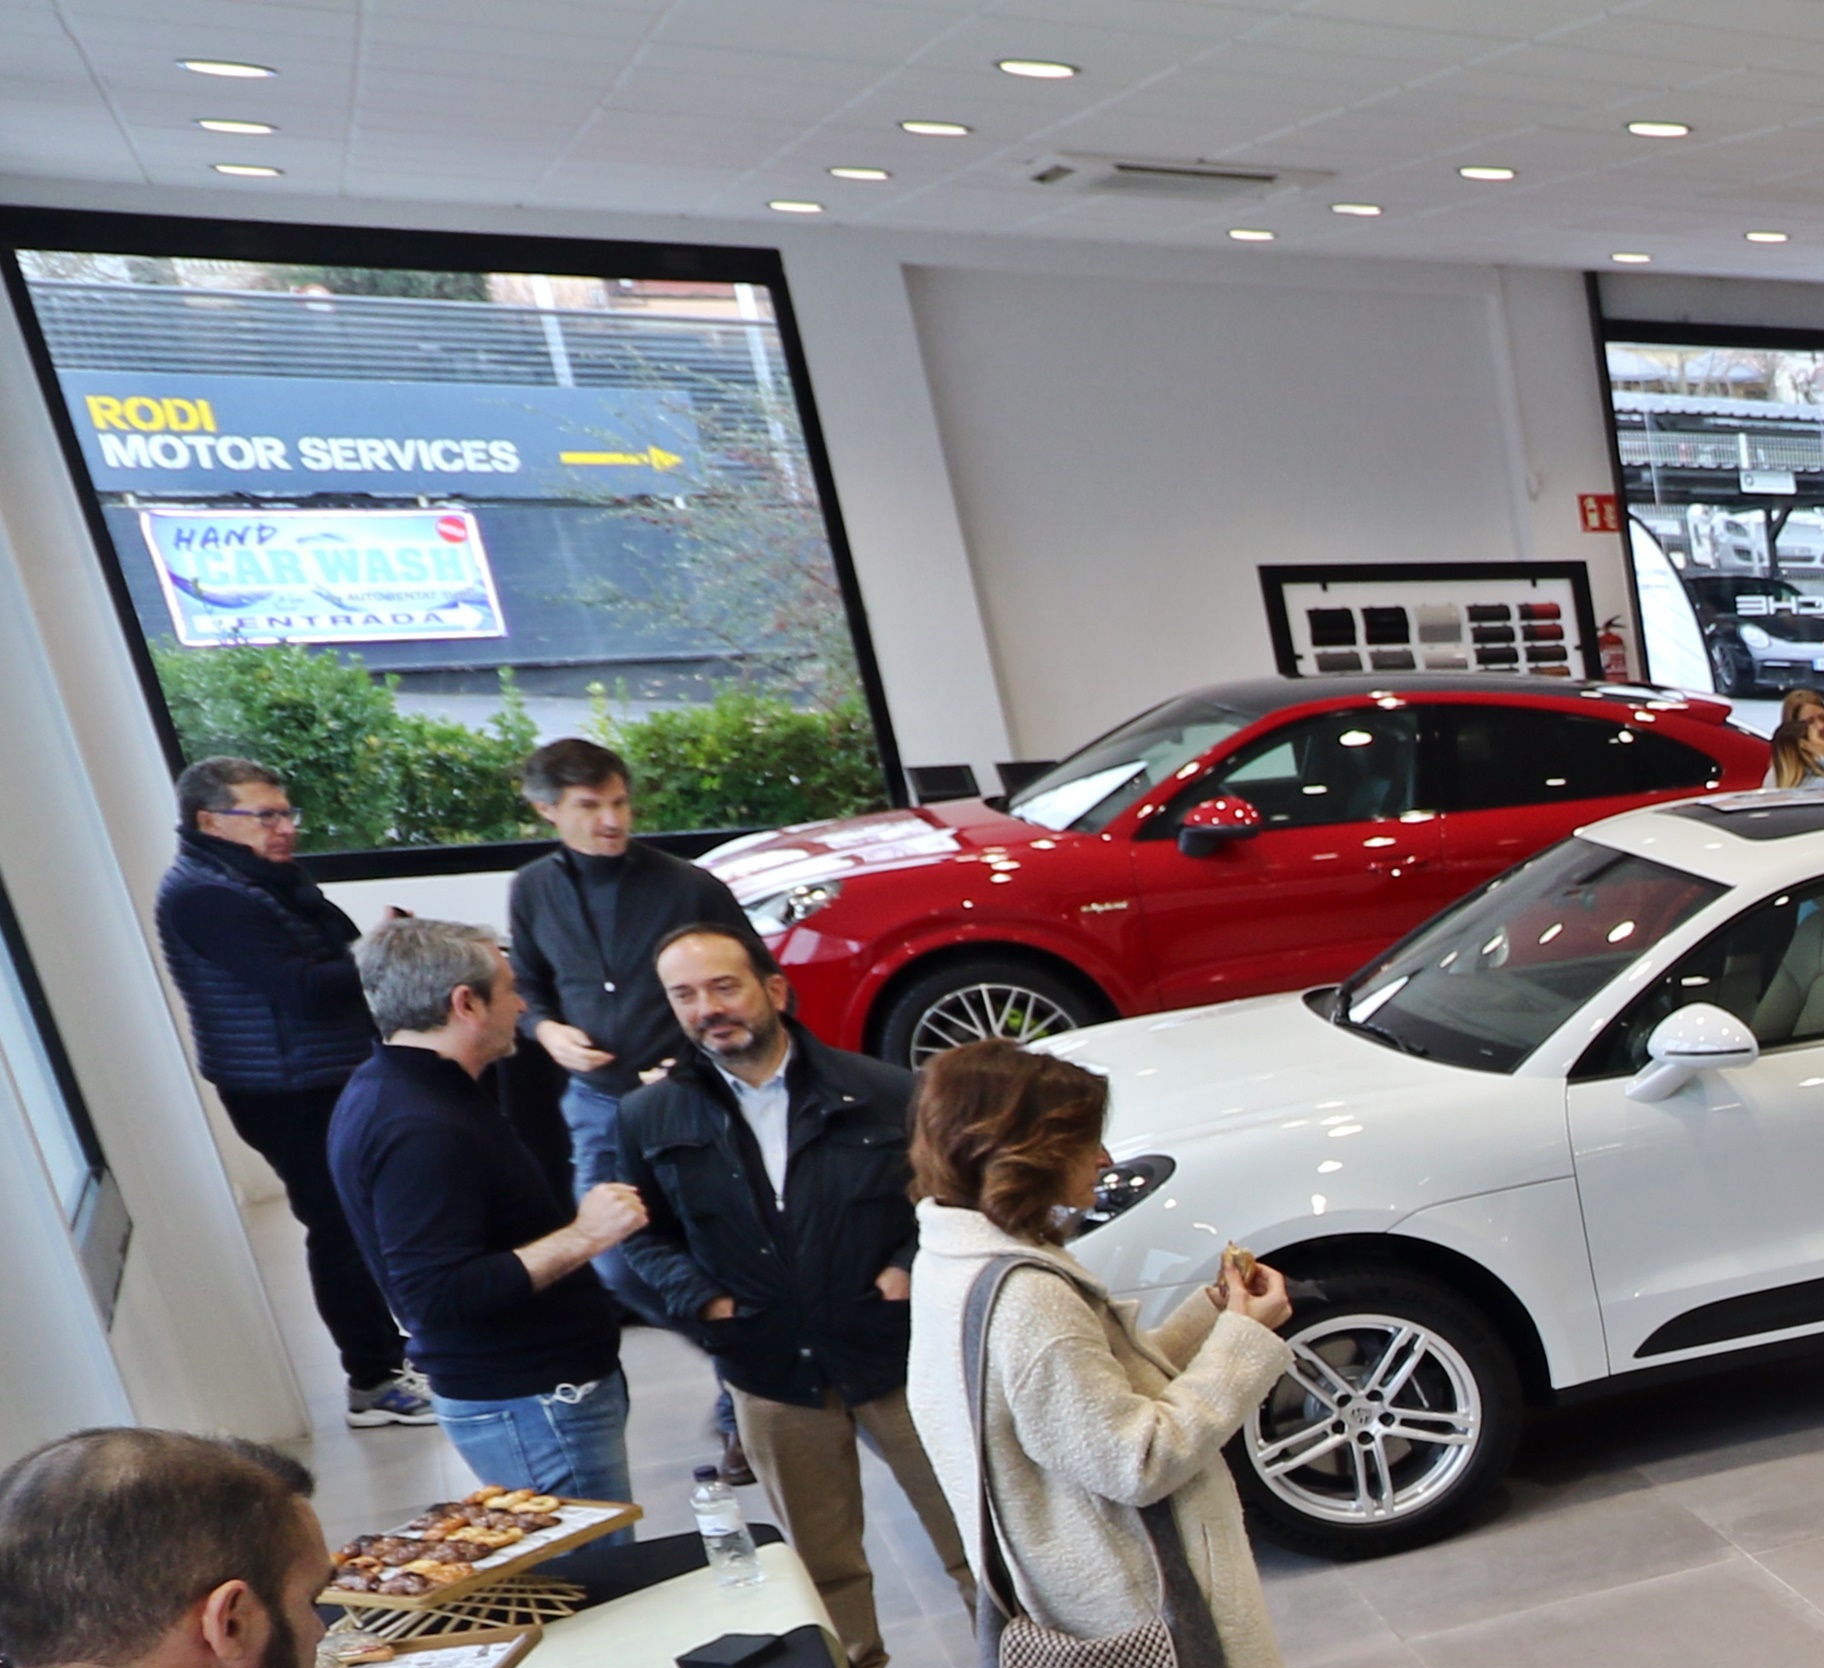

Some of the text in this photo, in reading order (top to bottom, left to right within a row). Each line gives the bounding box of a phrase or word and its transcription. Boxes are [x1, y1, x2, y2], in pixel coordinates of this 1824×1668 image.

[85, 395, 217, 432] RODI
[100, 433, 520, 473] MOTOR SERVICES
[173, 523, 278, 550] HAND
[202, 548, 467, 586] CAR WASH
[237, 612, 446, 629] ENTRADA
